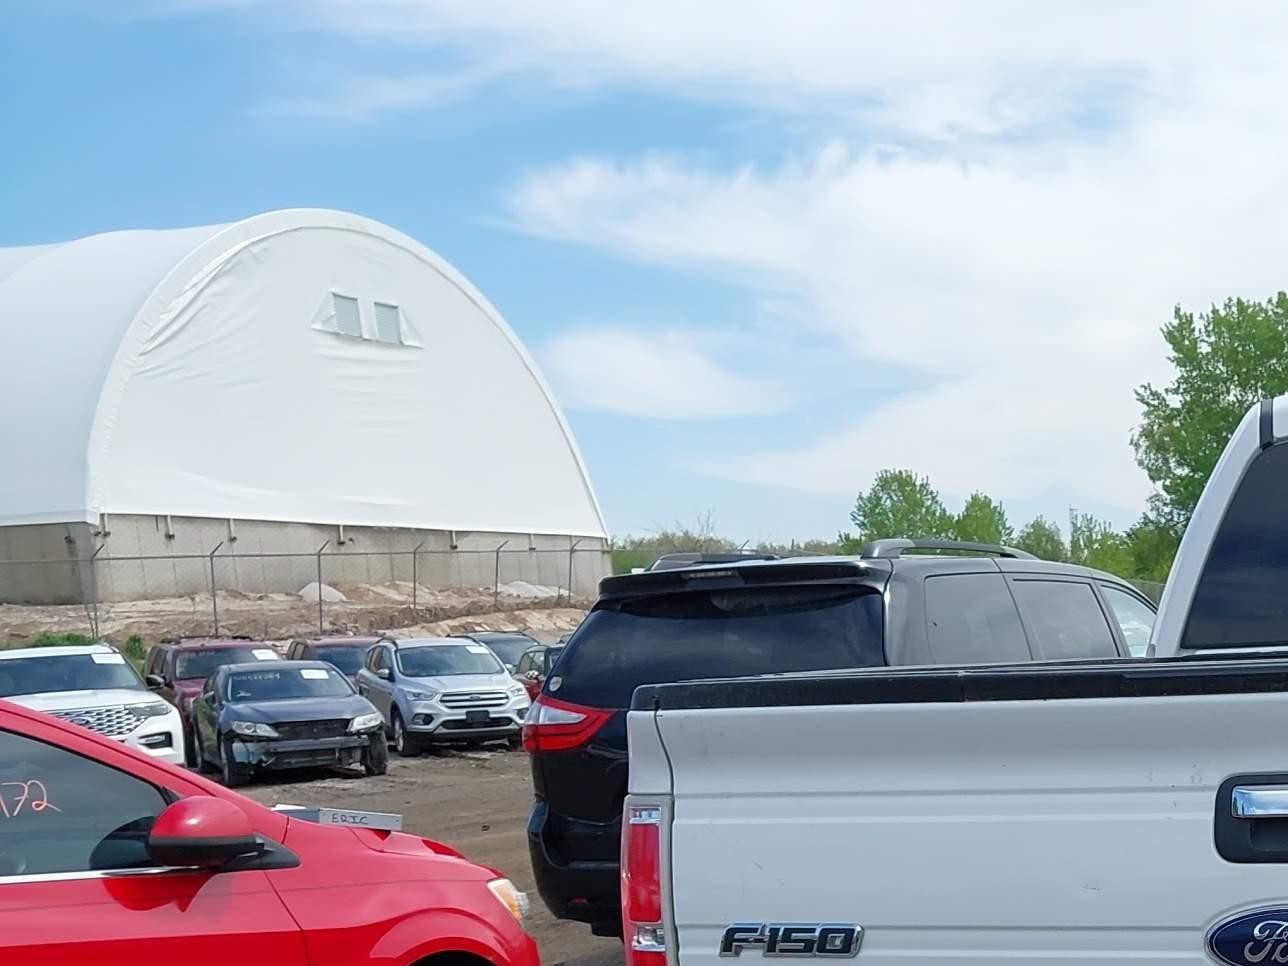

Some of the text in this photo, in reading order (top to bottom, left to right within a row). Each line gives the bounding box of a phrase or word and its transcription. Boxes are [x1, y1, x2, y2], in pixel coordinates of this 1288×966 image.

[0, 780, 62, 818] 72
[331, 813, 368, 825] ERIC
[719, 922, 865, 958] F-150
